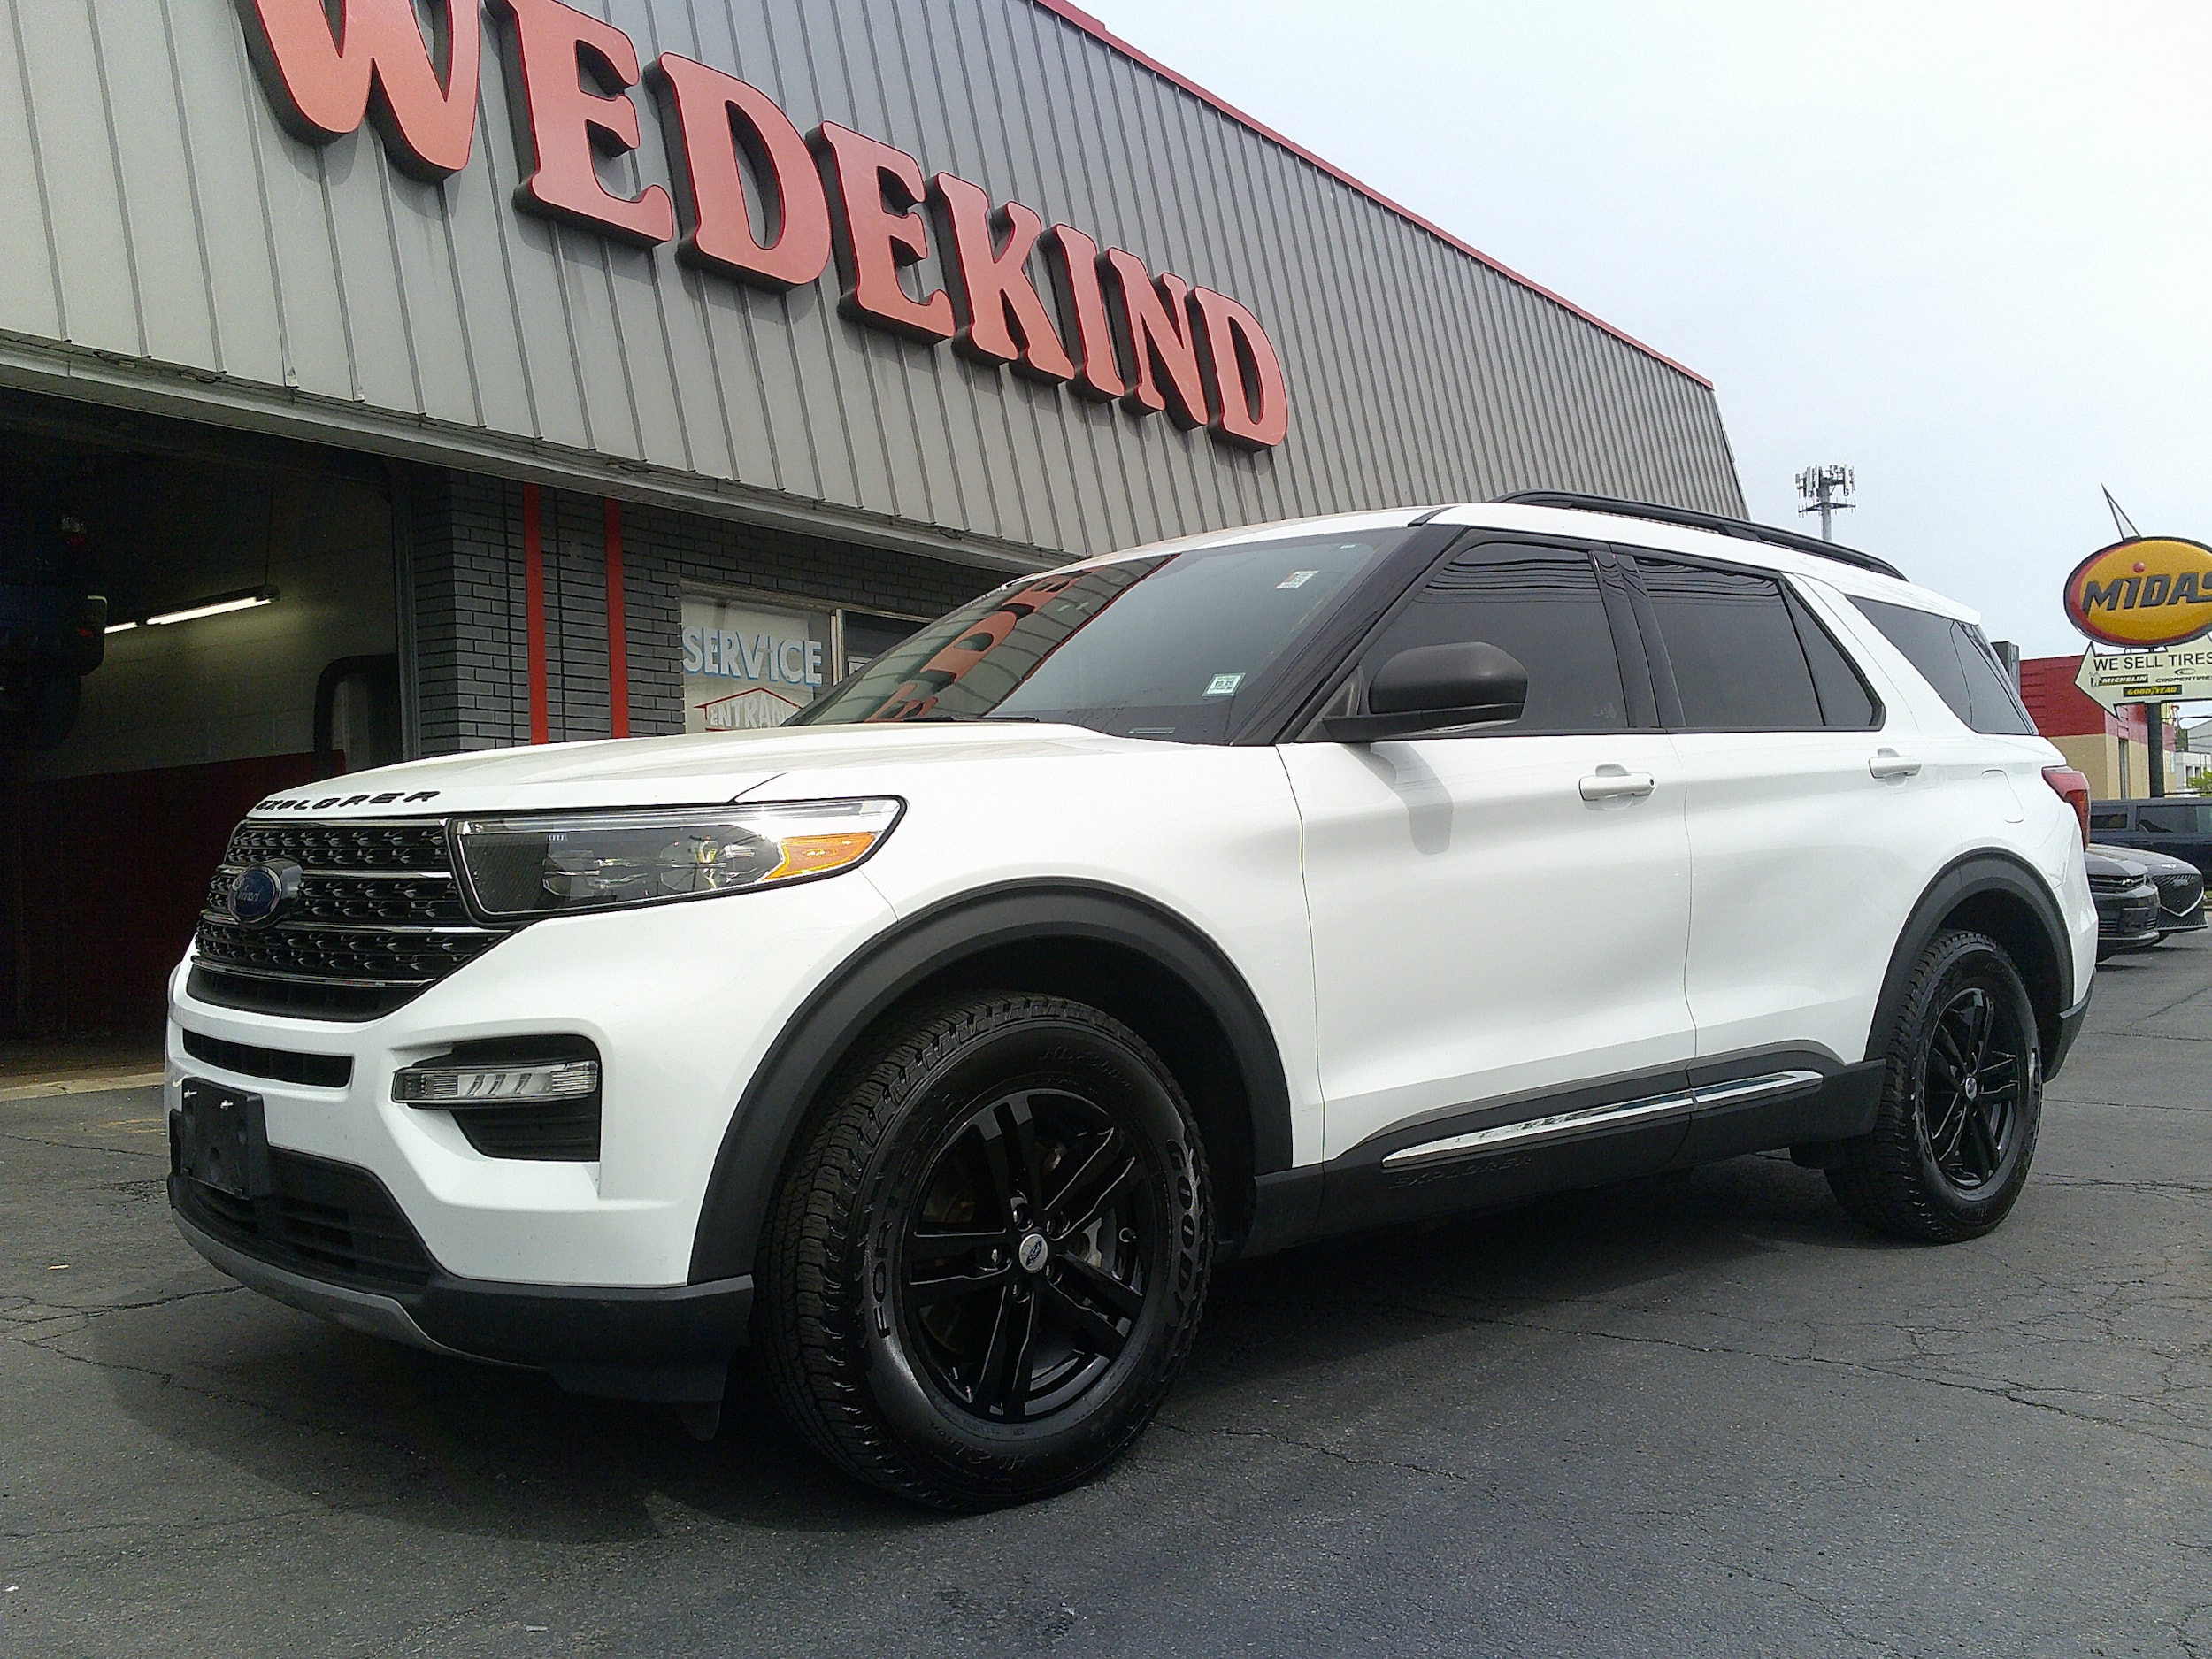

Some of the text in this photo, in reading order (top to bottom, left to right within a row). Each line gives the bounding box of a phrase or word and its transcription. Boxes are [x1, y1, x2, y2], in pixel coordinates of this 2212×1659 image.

[241, 0, 1289, 449] WEDEKIND
[681, 626, 823, 687] SERVICE
[2093, 651, 2212, 672] WE SELL TIRES
[2101, 675, 2147, 684] MICHELIN
[2126, 686, 2178, 696] GOODYEAR
[710, 693, 787, 728] ENTRAN
[255, 790, 442, 811] EXPLORER
